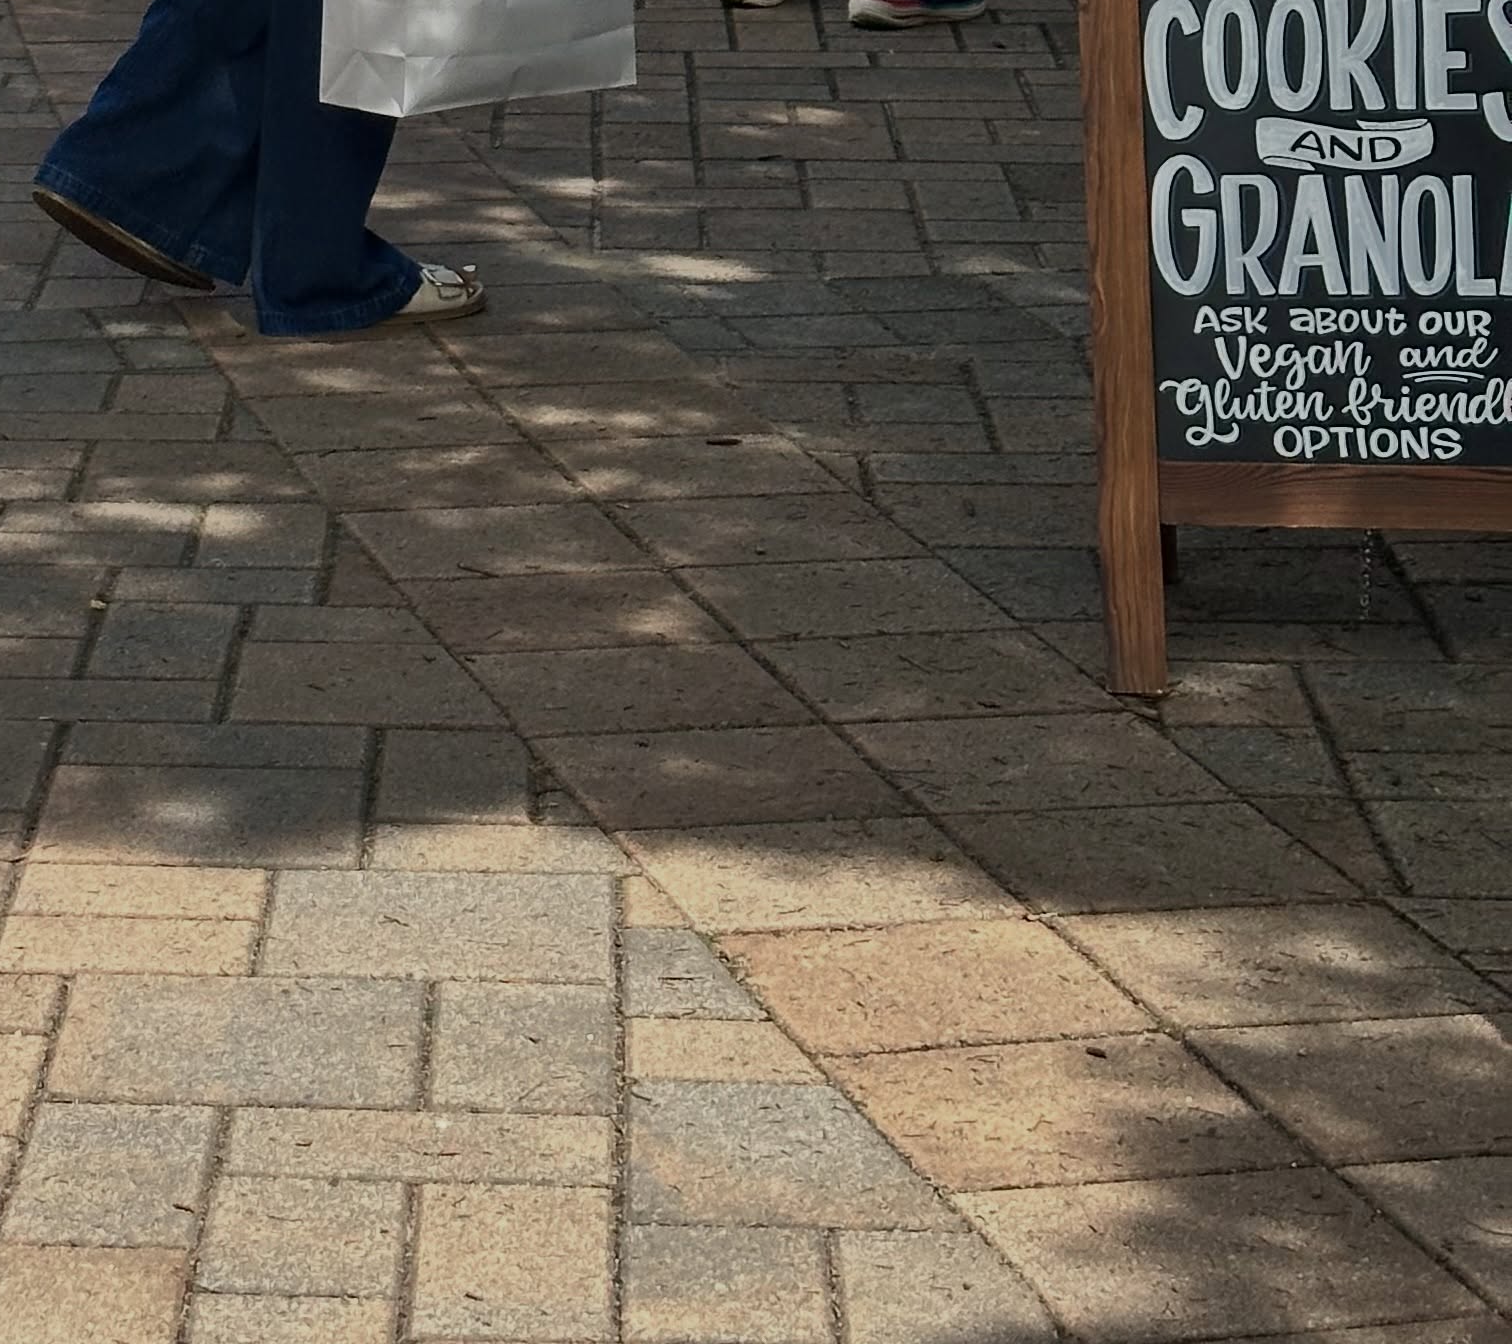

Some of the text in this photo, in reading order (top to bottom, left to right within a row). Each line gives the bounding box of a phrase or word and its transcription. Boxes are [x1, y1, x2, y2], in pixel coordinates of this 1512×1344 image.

[1290, 130, 1403, 163] AND
[1193, 305, 1268, 334] ASK
[1418, 310, 1492, 337] OUR
[1214, 335, 1498, 390] Vegan and
[1273, 425, 1463, 459] OPTIONS
